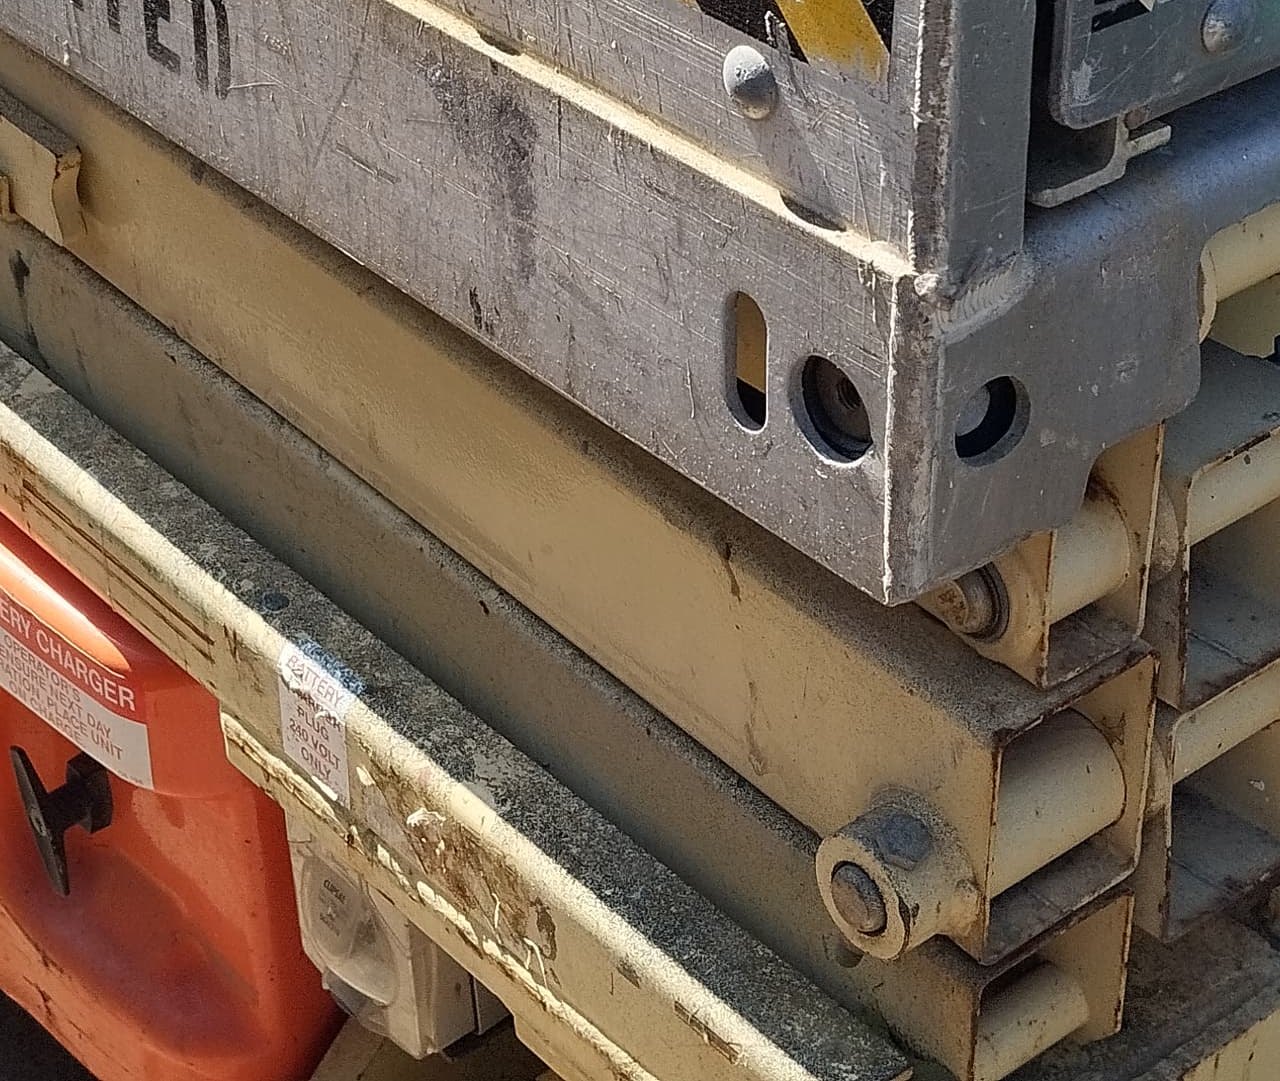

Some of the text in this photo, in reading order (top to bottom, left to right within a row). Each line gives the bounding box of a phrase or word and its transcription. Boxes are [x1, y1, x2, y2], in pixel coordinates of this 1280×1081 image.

[3, 633, 81, 703] OPERATOR'S
[36, 629, 136, 712] CHARGER
[287, 654, 345, 710] BATTERY
[30, 696, 82, 745] CHARGE
[46, 697, 88, 735] PLACE
[91, 727, 124, 761] UNIT
[49, 680, 83, 719] NEXT
[87, 712, 112, 739] DAY
[296, 705, 330, 742] PLUG
[289, 718, 341, 770] 240 VOLT
[300, 746, 332, 782] ONLY
